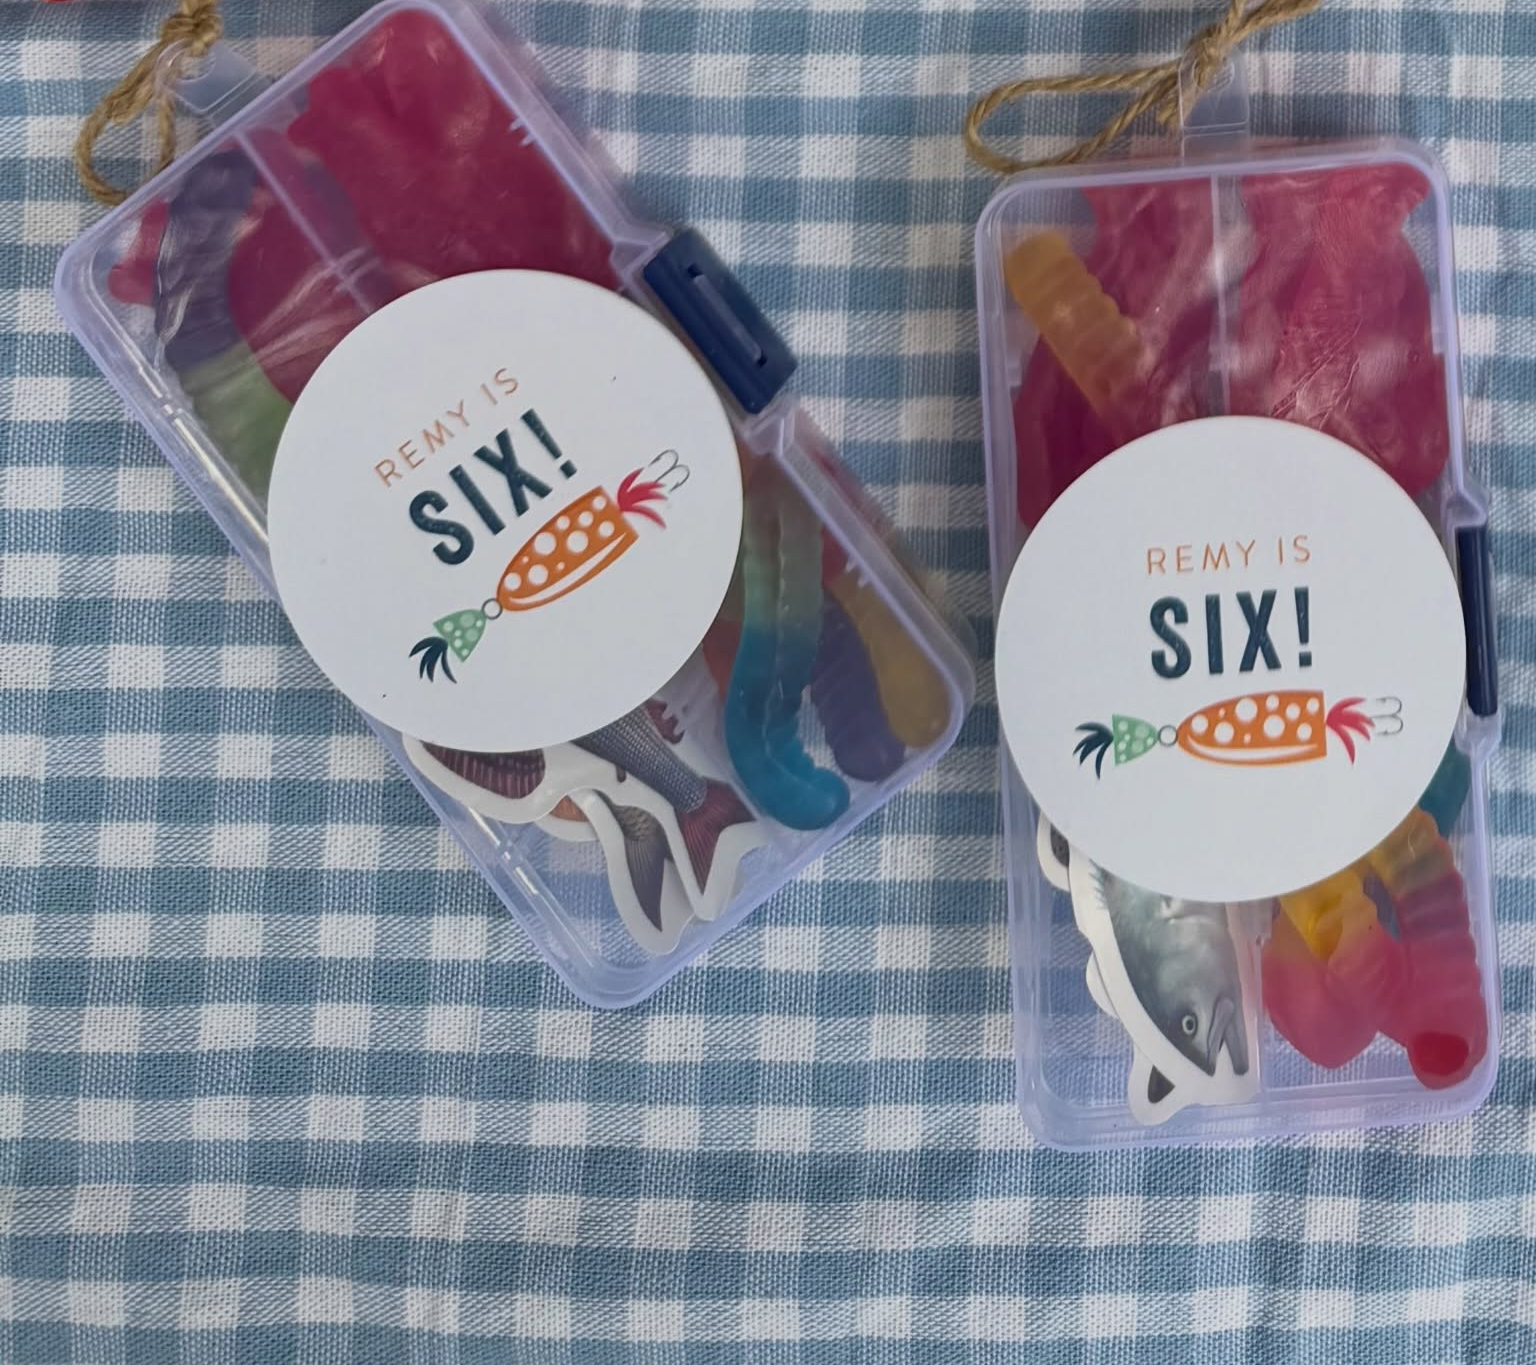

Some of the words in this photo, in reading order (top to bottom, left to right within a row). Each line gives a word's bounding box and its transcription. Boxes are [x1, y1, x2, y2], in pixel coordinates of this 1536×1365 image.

[374, 399, 470, 488] REMY
[480, 368, 519, 405] IS
[409, 408, 578, 565] SIX!
[1146, 539, 1257, 576] REMY
[1277, 534, 1312, 565] IS
[1150, 586, 1312, 680] SIX!
